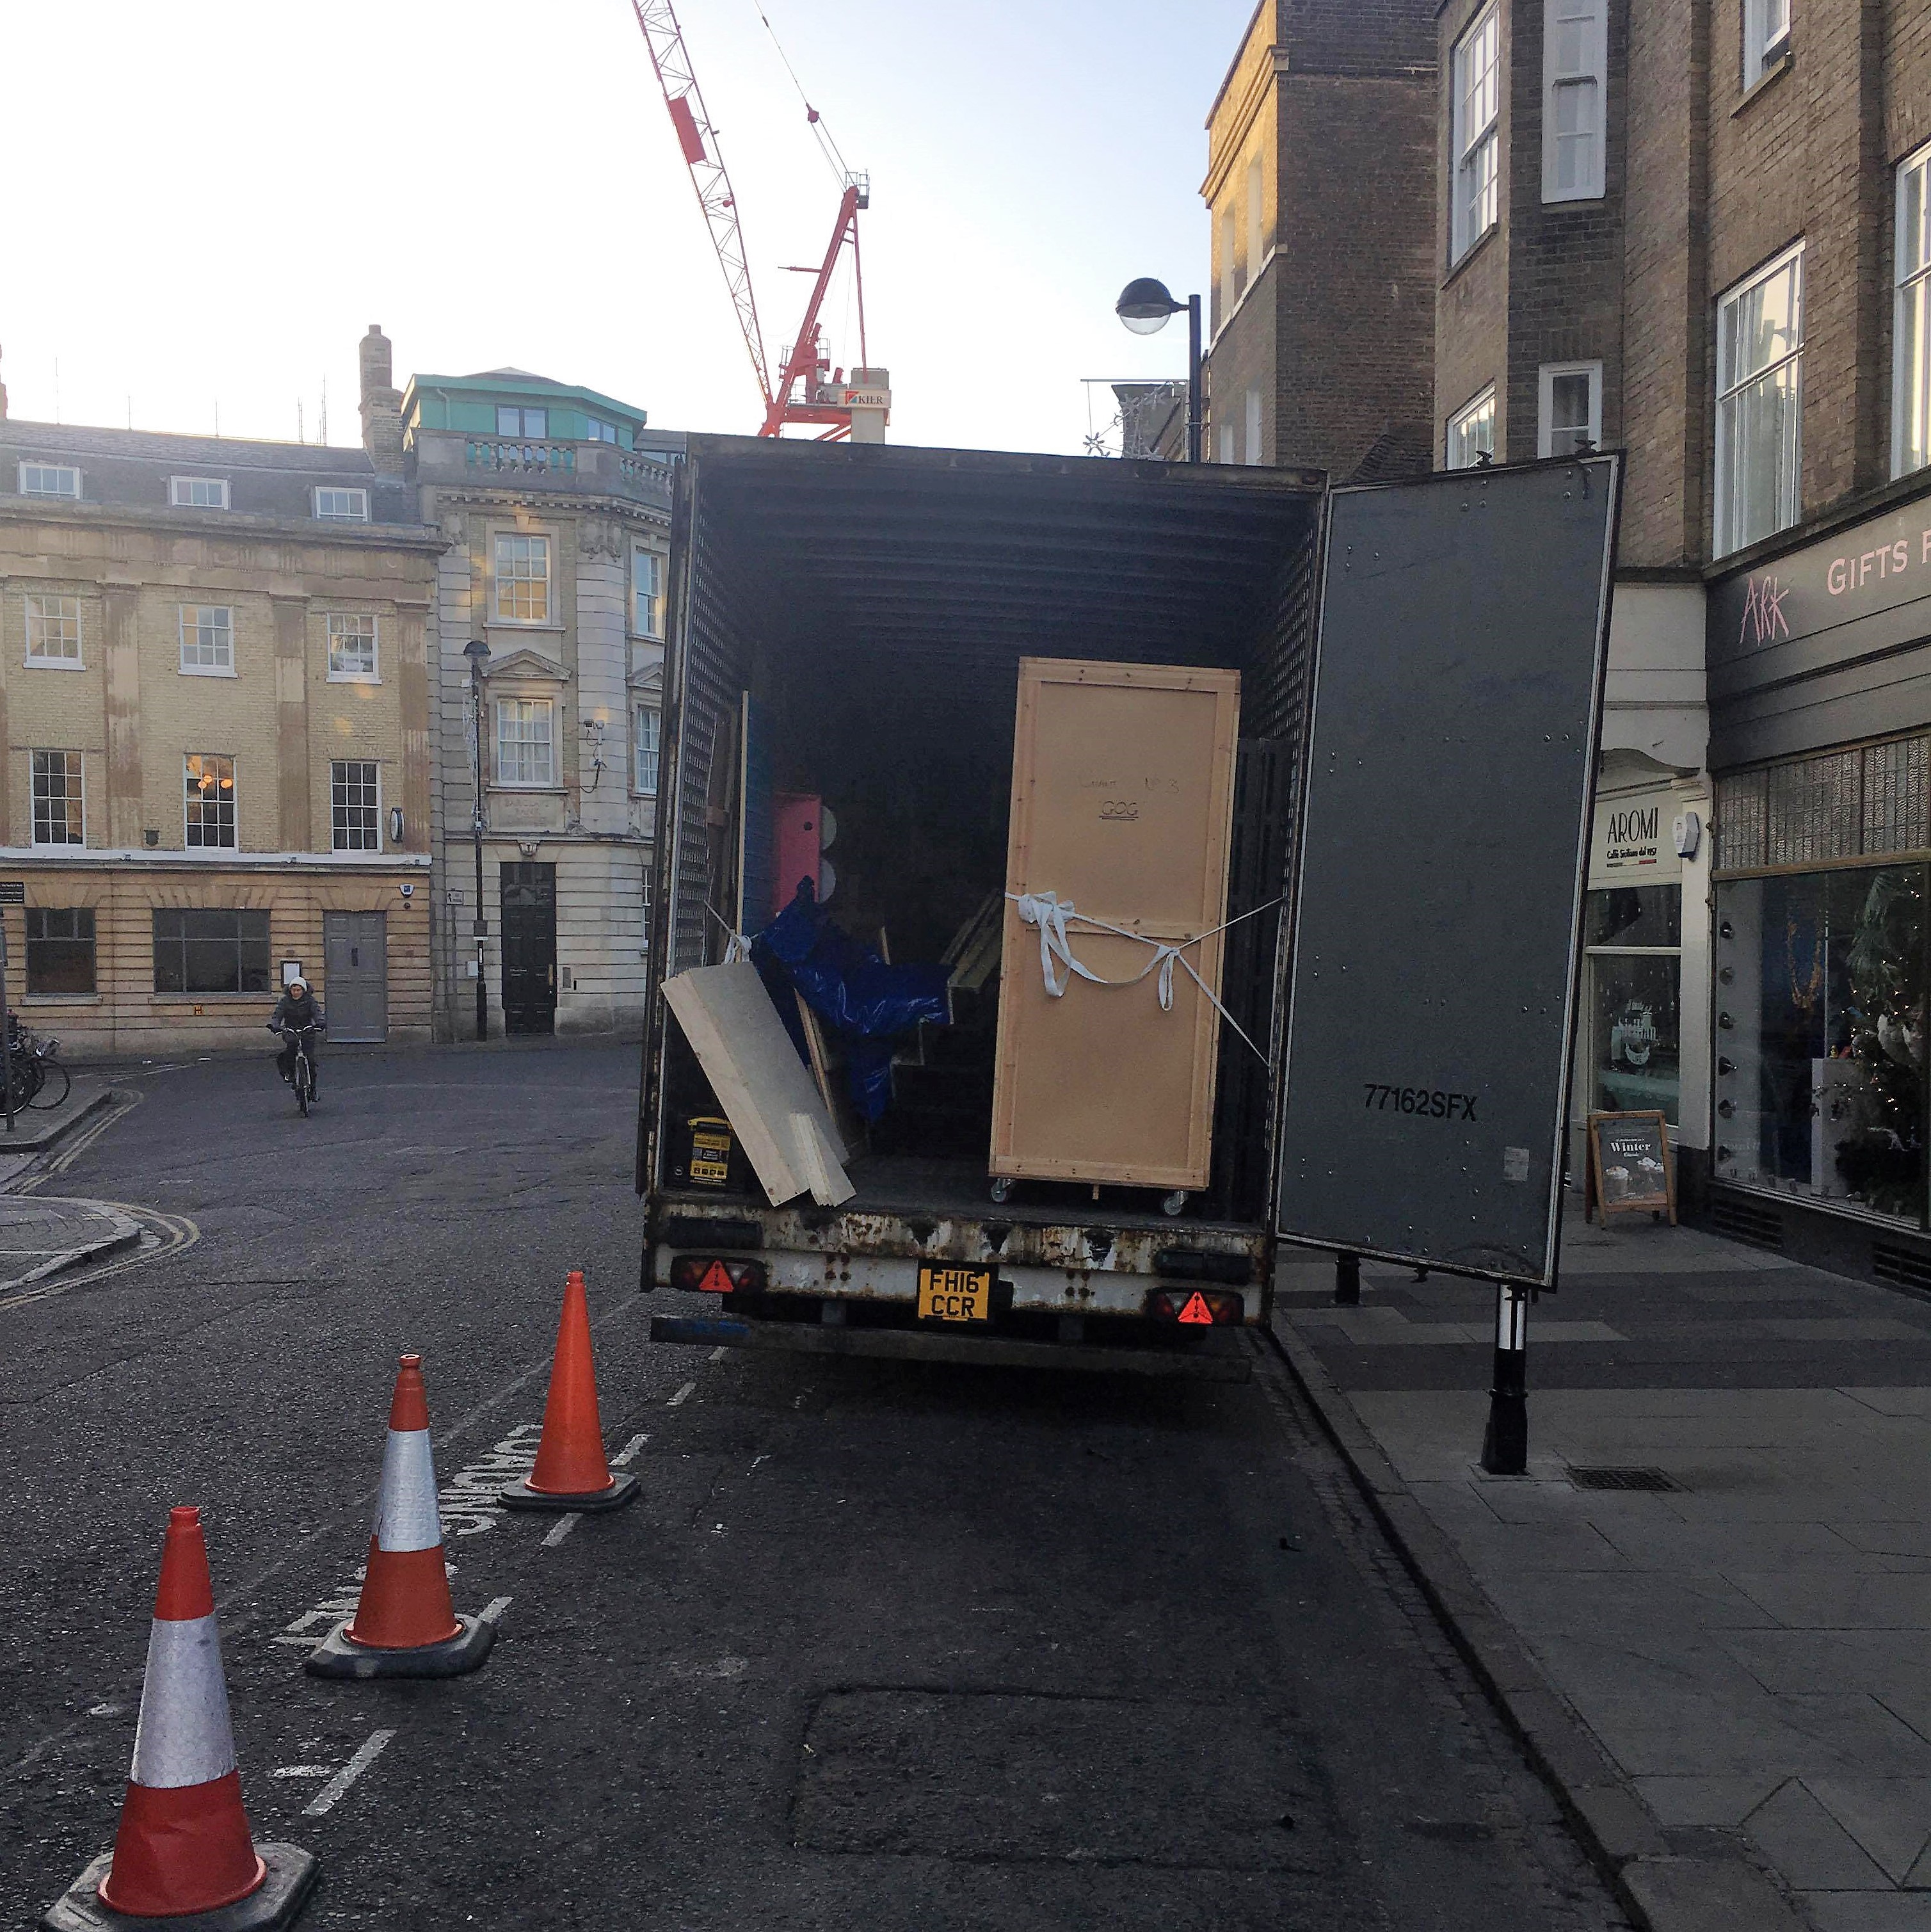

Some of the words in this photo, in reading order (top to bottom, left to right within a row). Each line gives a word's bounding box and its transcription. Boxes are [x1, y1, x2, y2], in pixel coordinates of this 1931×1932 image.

[858, 395, 883, 404] KIER
[1827, 540, 1909, 595] GIFTS
[1740, 576, 1790, 646] ARK
[1607, 807, 1658, 844] AROMI
[1363, 1083, 1477, 1122] 77162SFX
[1610, 1142, 1651, 1152] Winter
[929, 1271, 979, 1292] FH16
[931, 1295, 975, 1317] CCR
